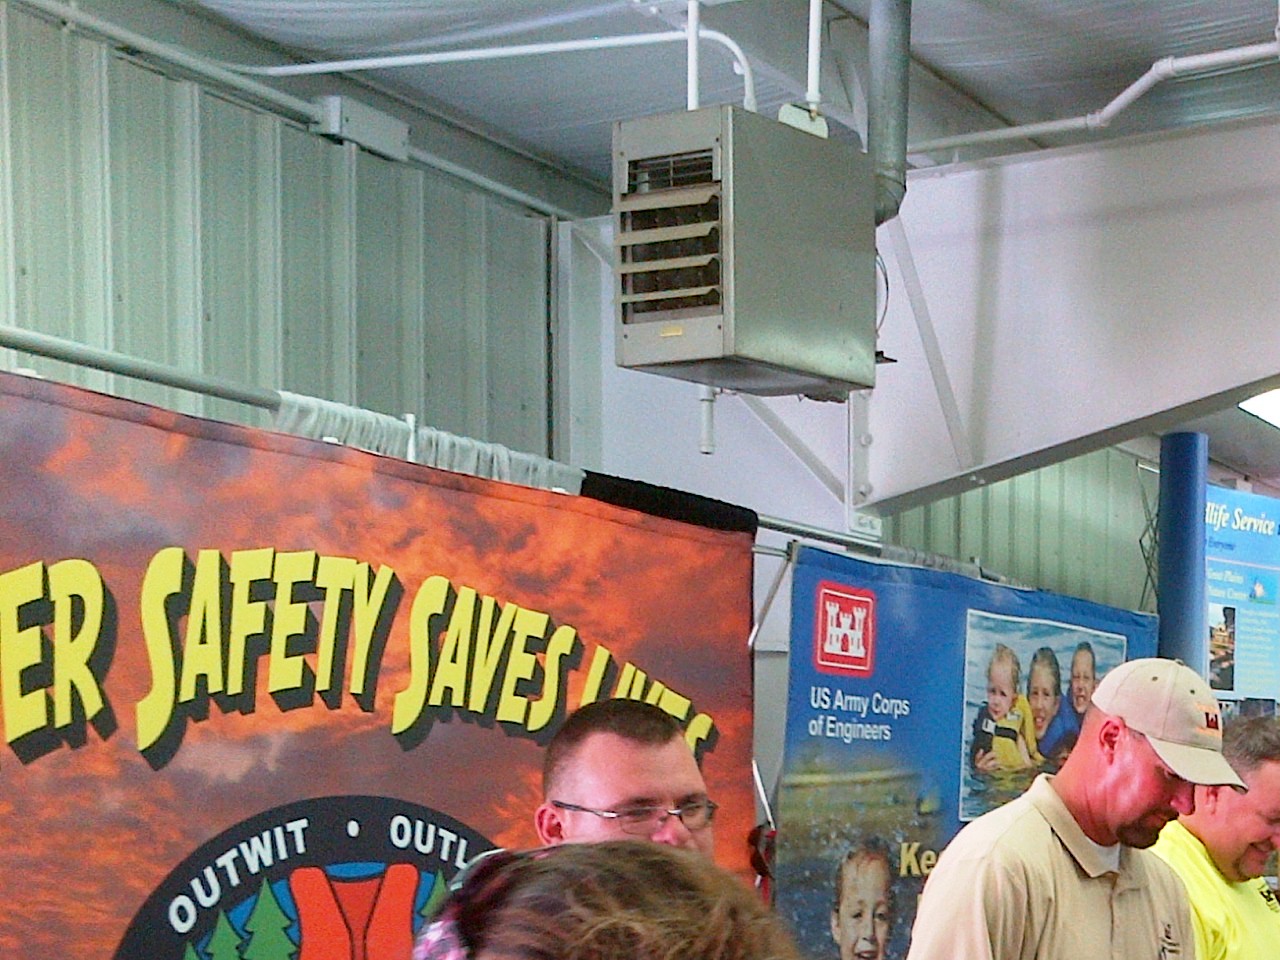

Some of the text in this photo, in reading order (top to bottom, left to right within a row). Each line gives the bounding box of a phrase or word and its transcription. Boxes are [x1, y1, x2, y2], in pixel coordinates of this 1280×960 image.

[1232, 507, 1276, 538] Service
[136, 546, 394, 751] SAFETY
[391, 574, 578, 735] SAVES
[810, 686, 911, 718] US Army Corps
[808, 714, 893, 743] of Engineers
[168, 817, 309, 934] OUTWIT
[900, 841, 940, 878] Ke
